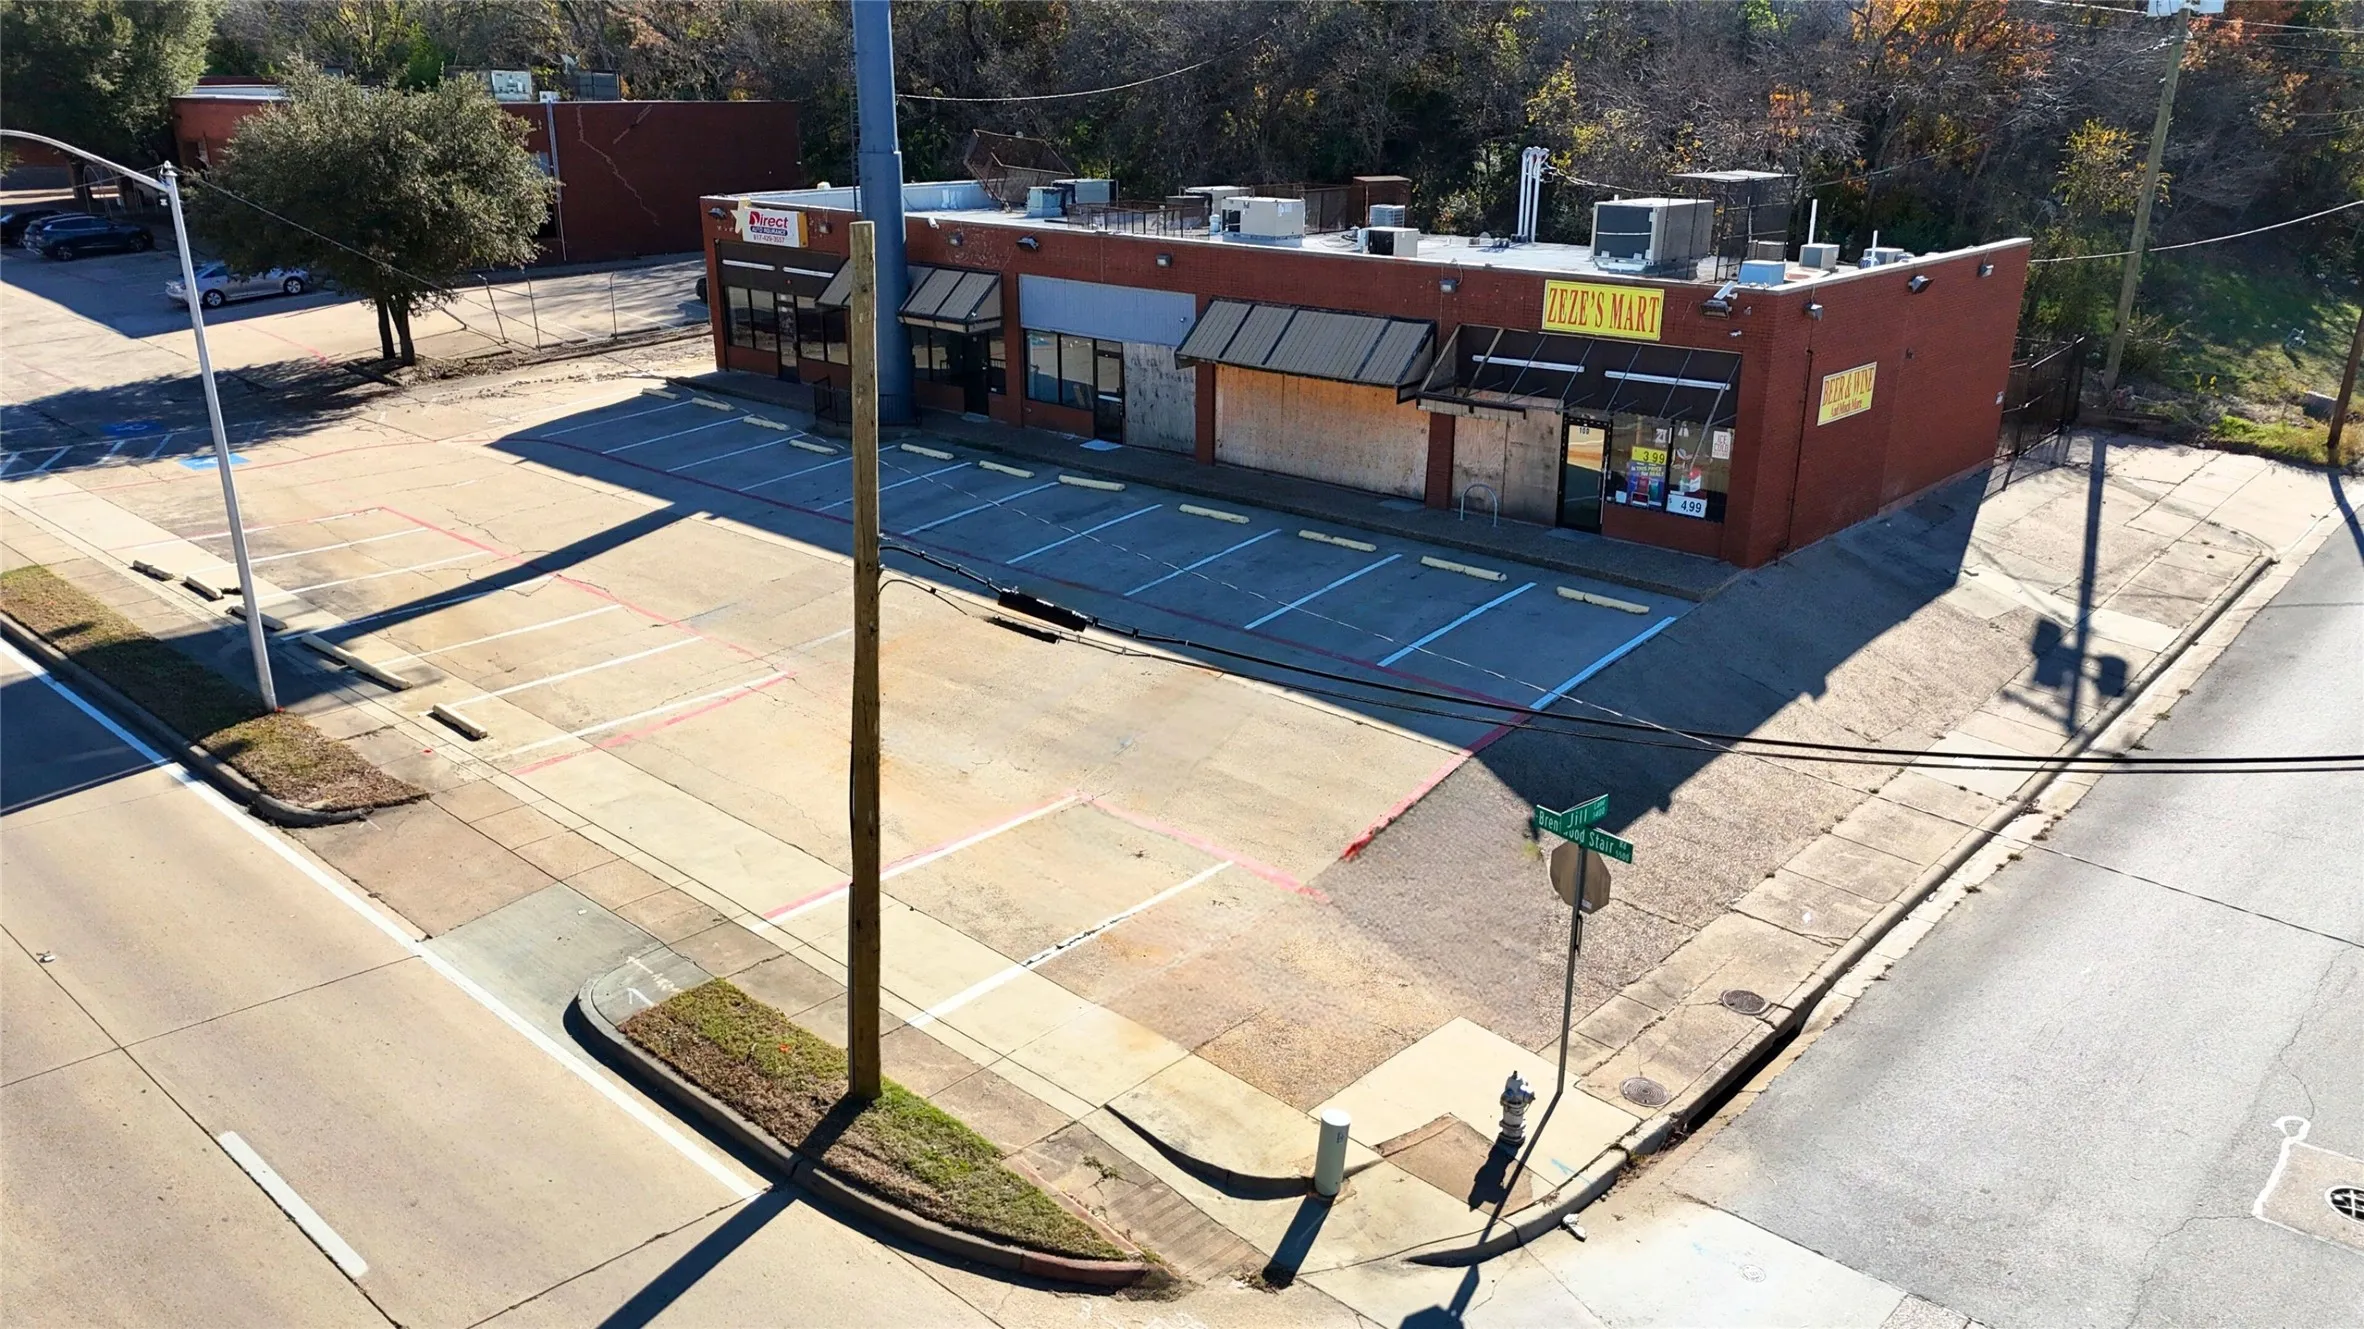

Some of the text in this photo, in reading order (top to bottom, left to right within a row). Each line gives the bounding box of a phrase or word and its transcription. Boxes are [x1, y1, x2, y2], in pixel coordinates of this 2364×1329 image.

[749, 211, 788, 228] Direct
[1547, 288, 1659, 333] ZEZE'S MART
[1823, 368, 1874, 406] BEER & WINE
[1681, 500, 1702, 513] 4.99
[1567, 808, 1587, 828] Jill
[1588, 831, 1614, 854] Stair
